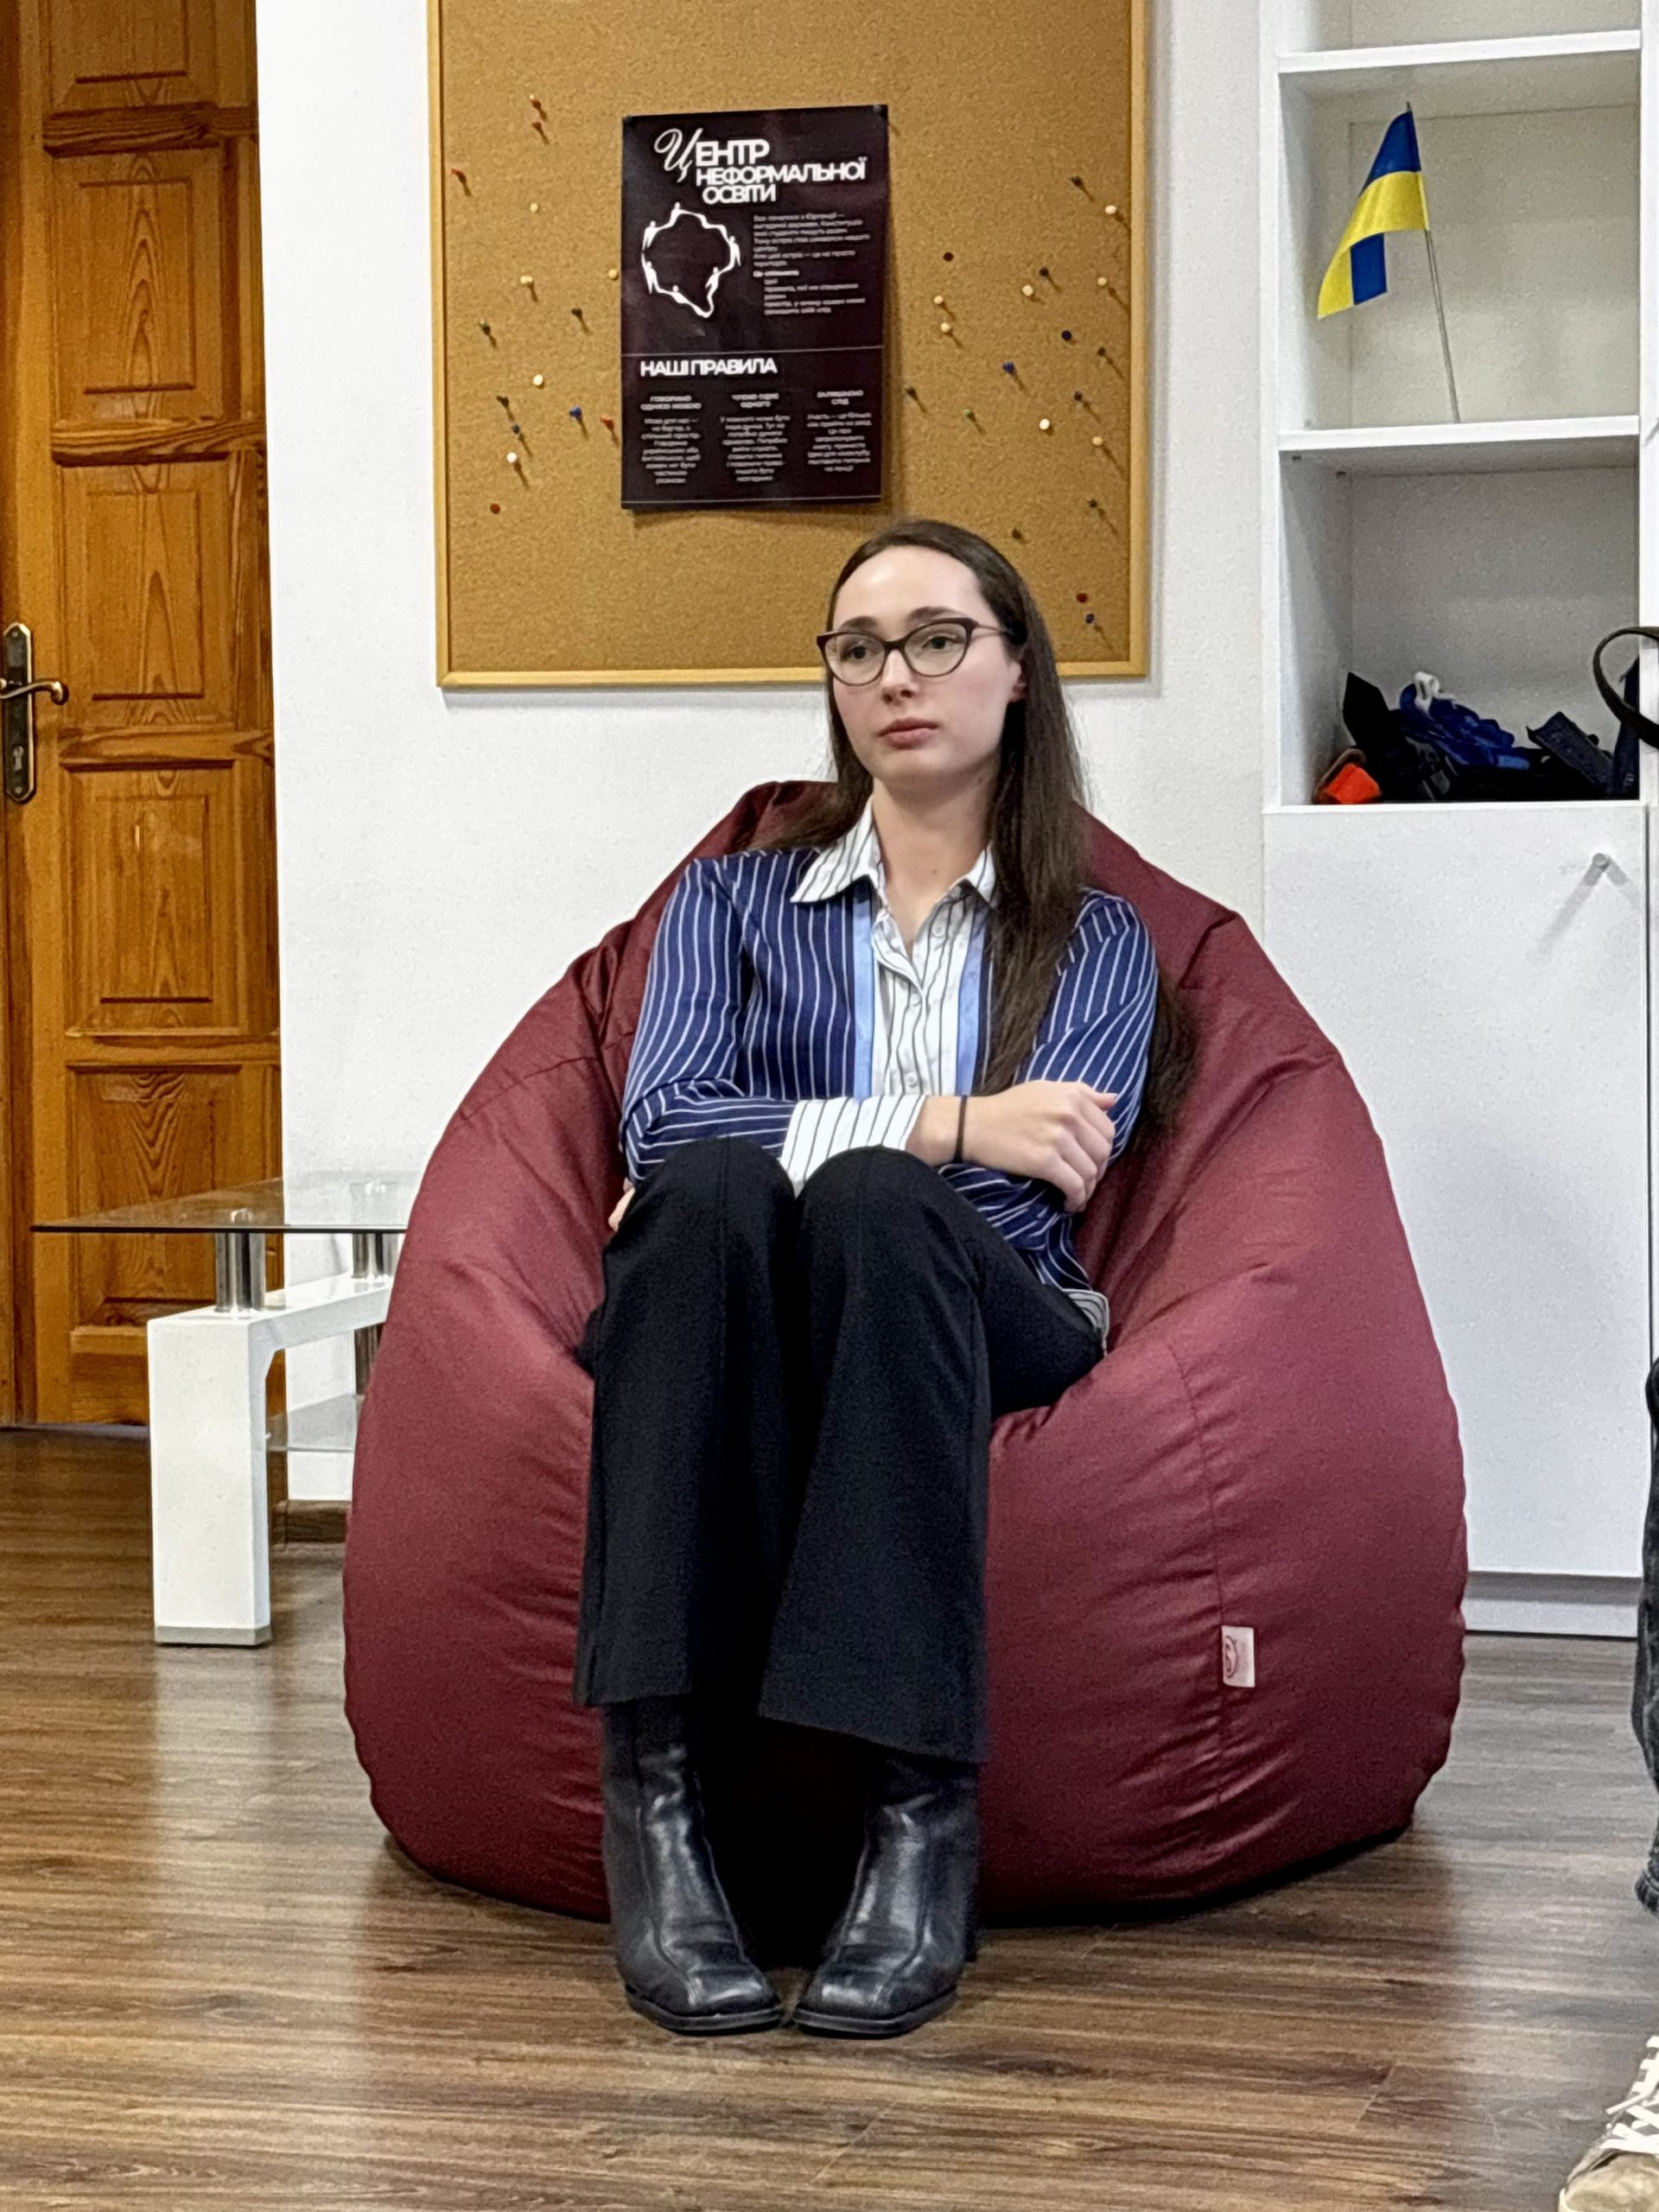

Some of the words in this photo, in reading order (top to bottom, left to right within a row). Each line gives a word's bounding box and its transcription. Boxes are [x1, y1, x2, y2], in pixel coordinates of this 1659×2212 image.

[654, 128, 770, 182] ЦЕНТР
[696, 156, 868, 187] НЕФОРМАЛЬНОЇ
[702, 184, 777, 205] ОСВІТИ
[640, 359, 689, 377] НАШІ
[690, 358, 778, 376] ПРАВИЛА
